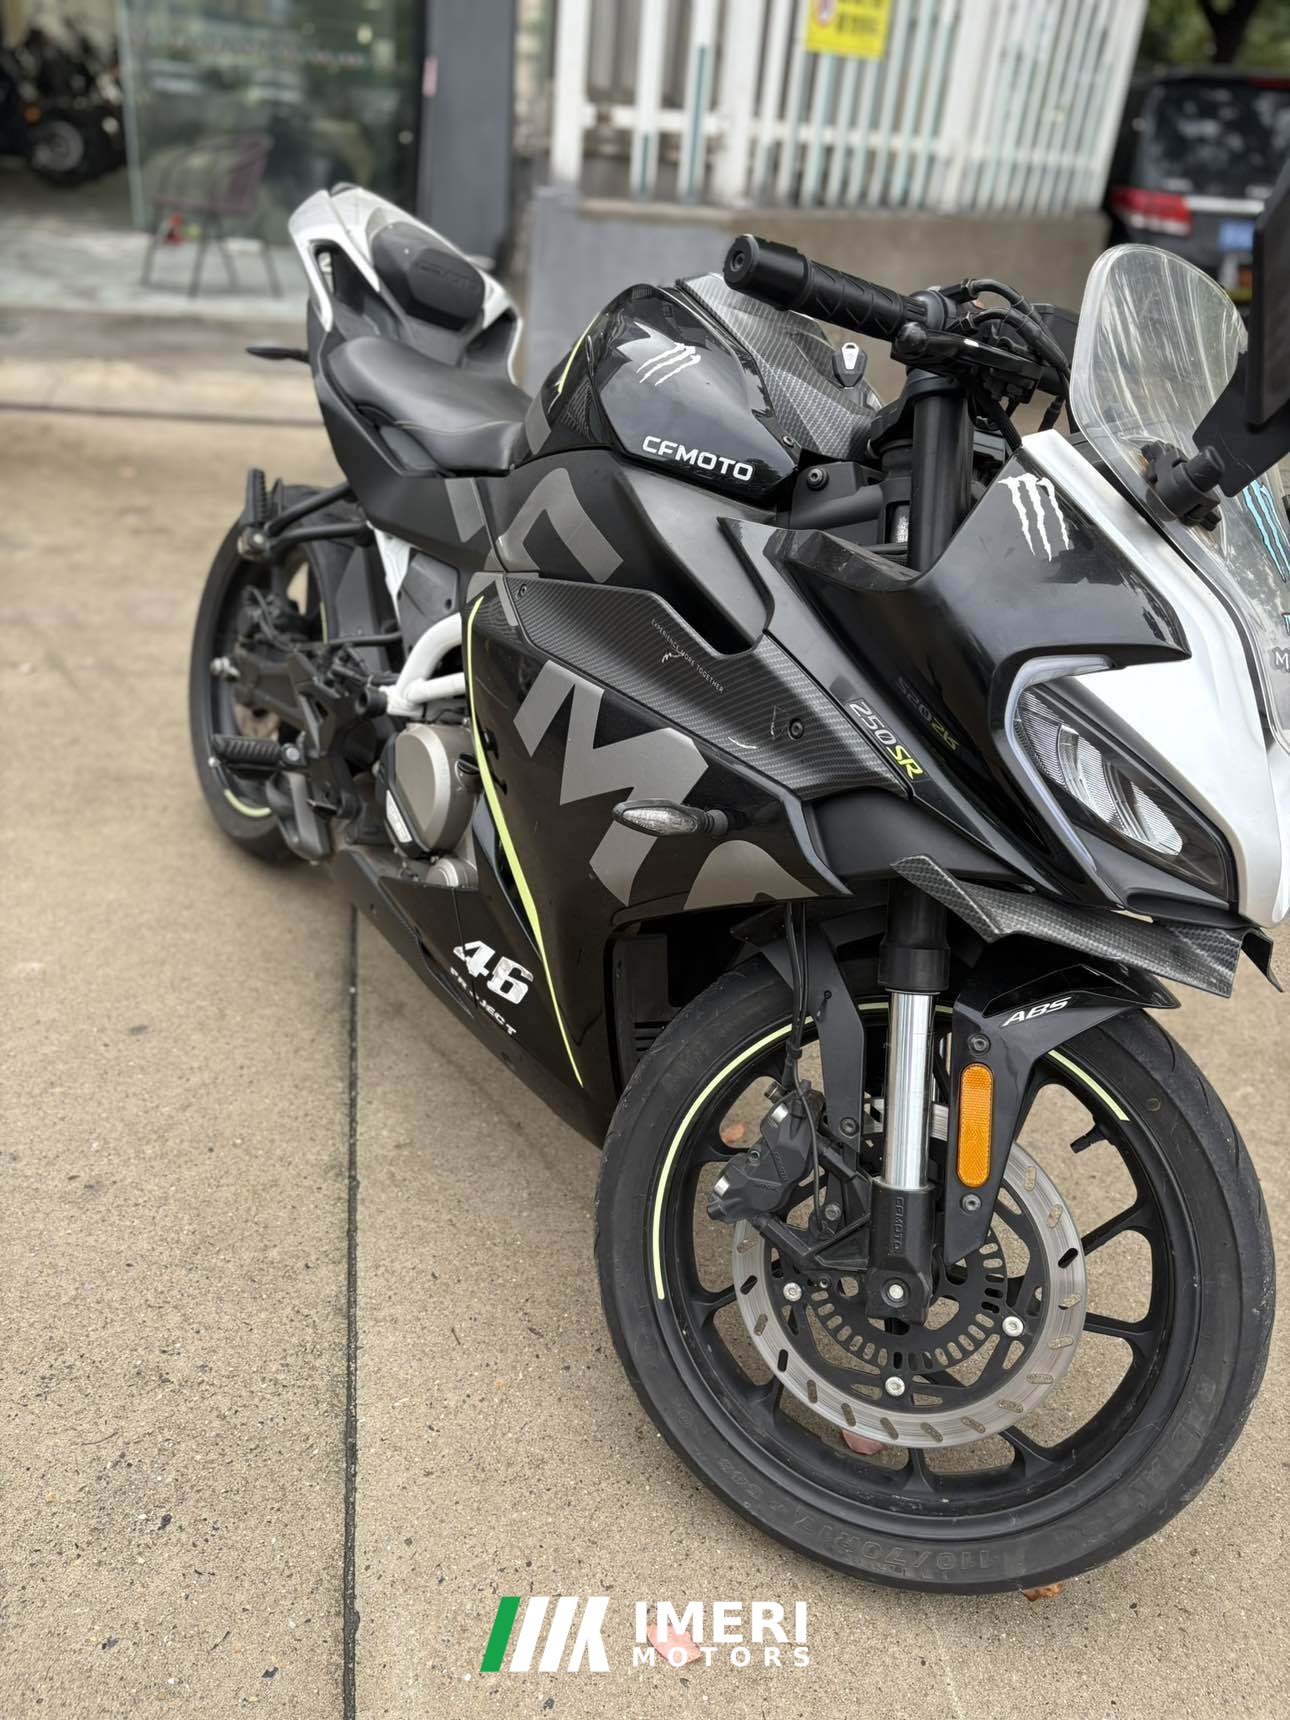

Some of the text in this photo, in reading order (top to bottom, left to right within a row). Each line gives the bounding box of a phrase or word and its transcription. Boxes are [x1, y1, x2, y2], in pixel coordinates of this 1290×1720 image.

[642, 435, 754, 482] CFMOTO
[696, 664, 724, 694] TOGETHER
[849, 701, 924, 780] 250SR
[452, 940, 534, 1005] 46
[1001, 996, 1073, 1028] ABS
